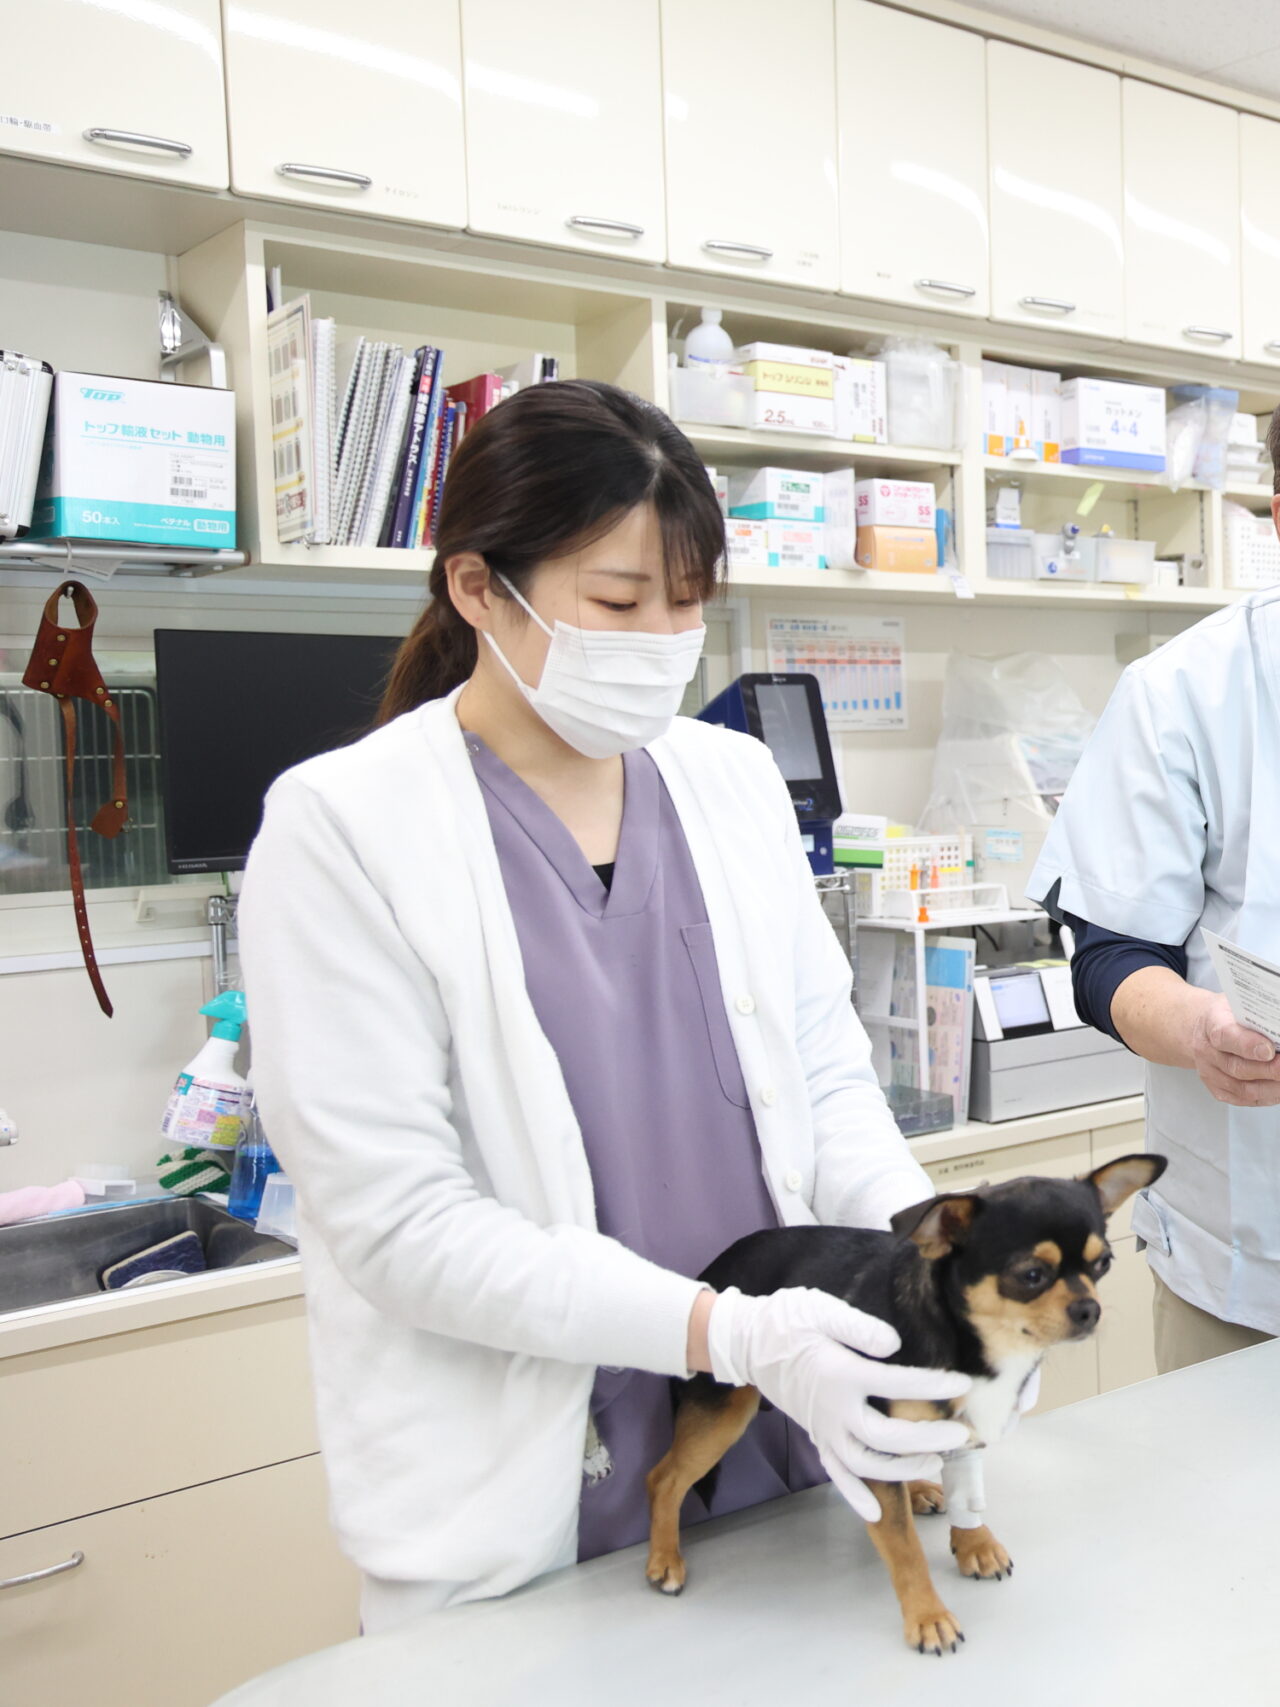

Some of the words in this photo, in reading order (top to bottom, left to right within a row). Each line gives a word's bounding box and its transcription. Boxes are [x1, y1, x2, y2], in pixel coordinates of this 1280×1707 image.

[84, 421, 182, 440] トップ輸液セット
[187, 431, 226, 447] 動物用
